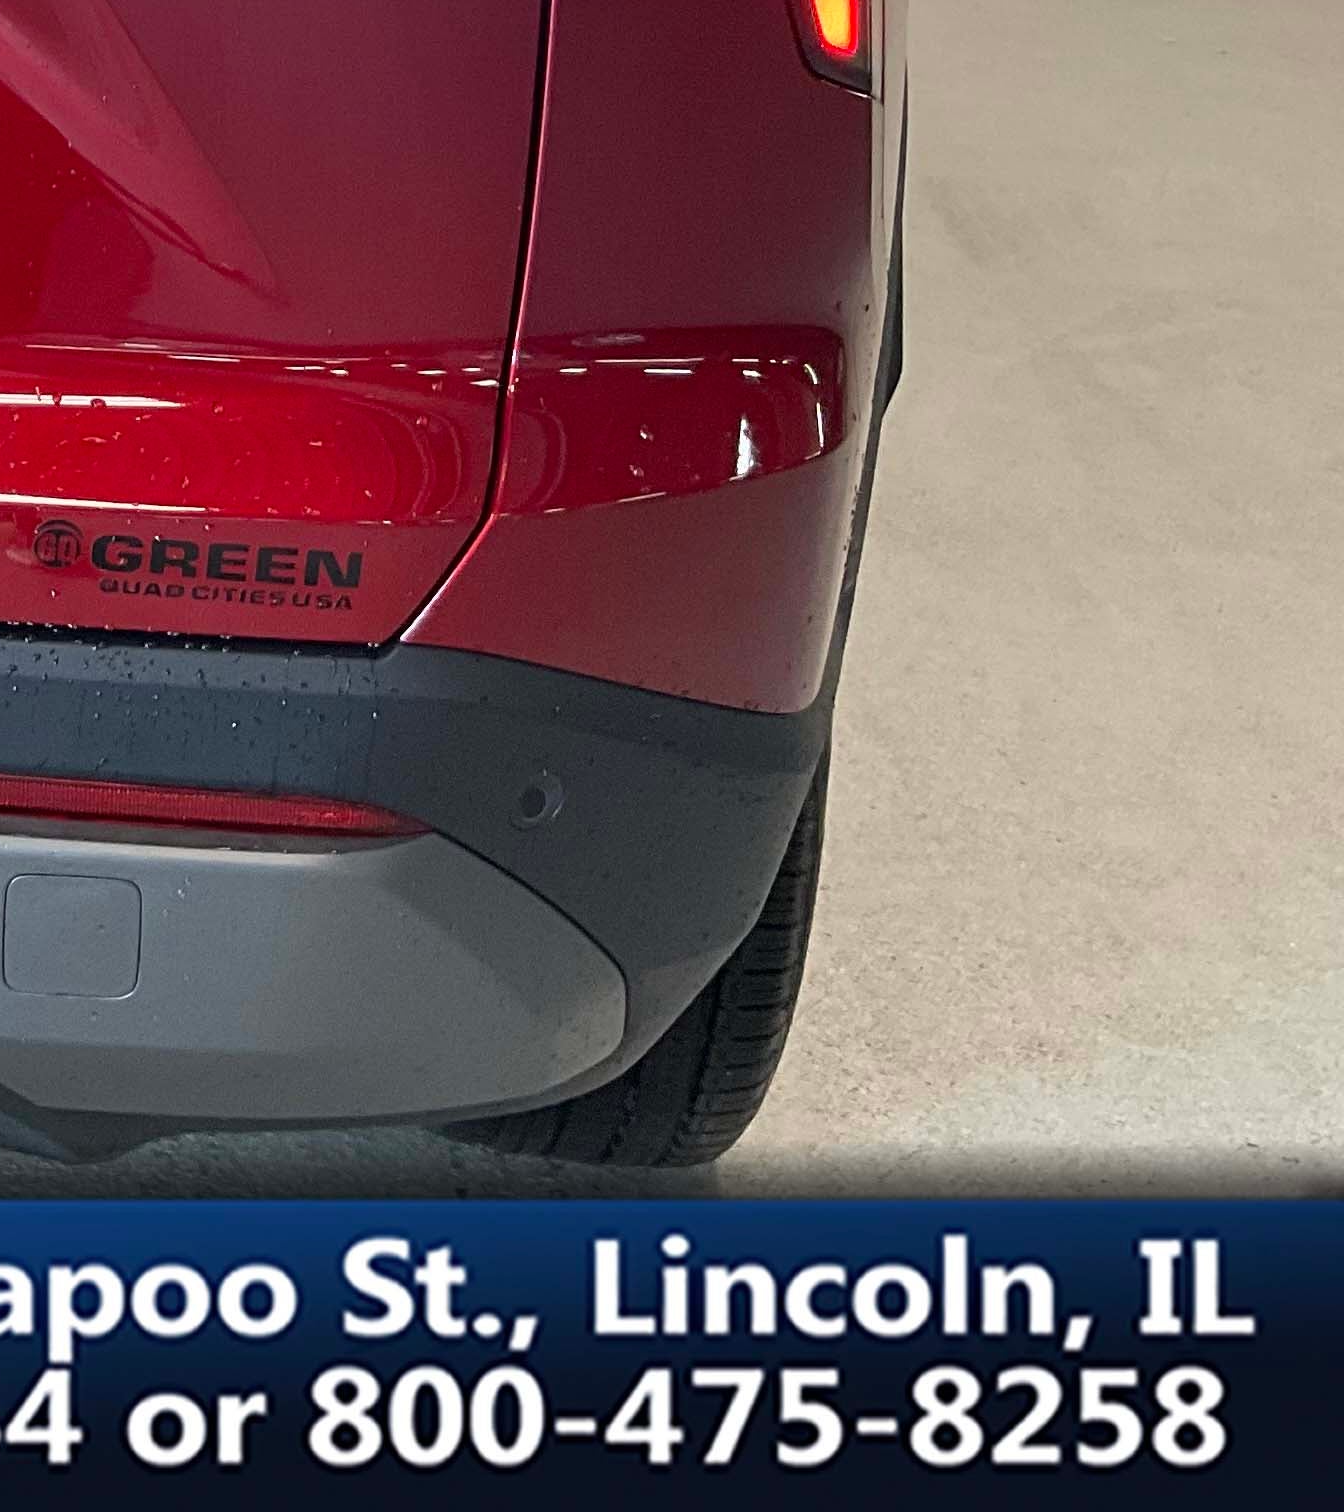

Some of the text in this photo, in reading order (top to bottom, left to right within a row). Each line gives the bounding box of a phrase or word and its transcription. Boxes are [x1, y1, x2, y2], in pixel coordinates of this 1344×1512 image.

[91, 535, 363, 588] GREEN
[100, 579, 354, 611] QUAD CITIES USA
